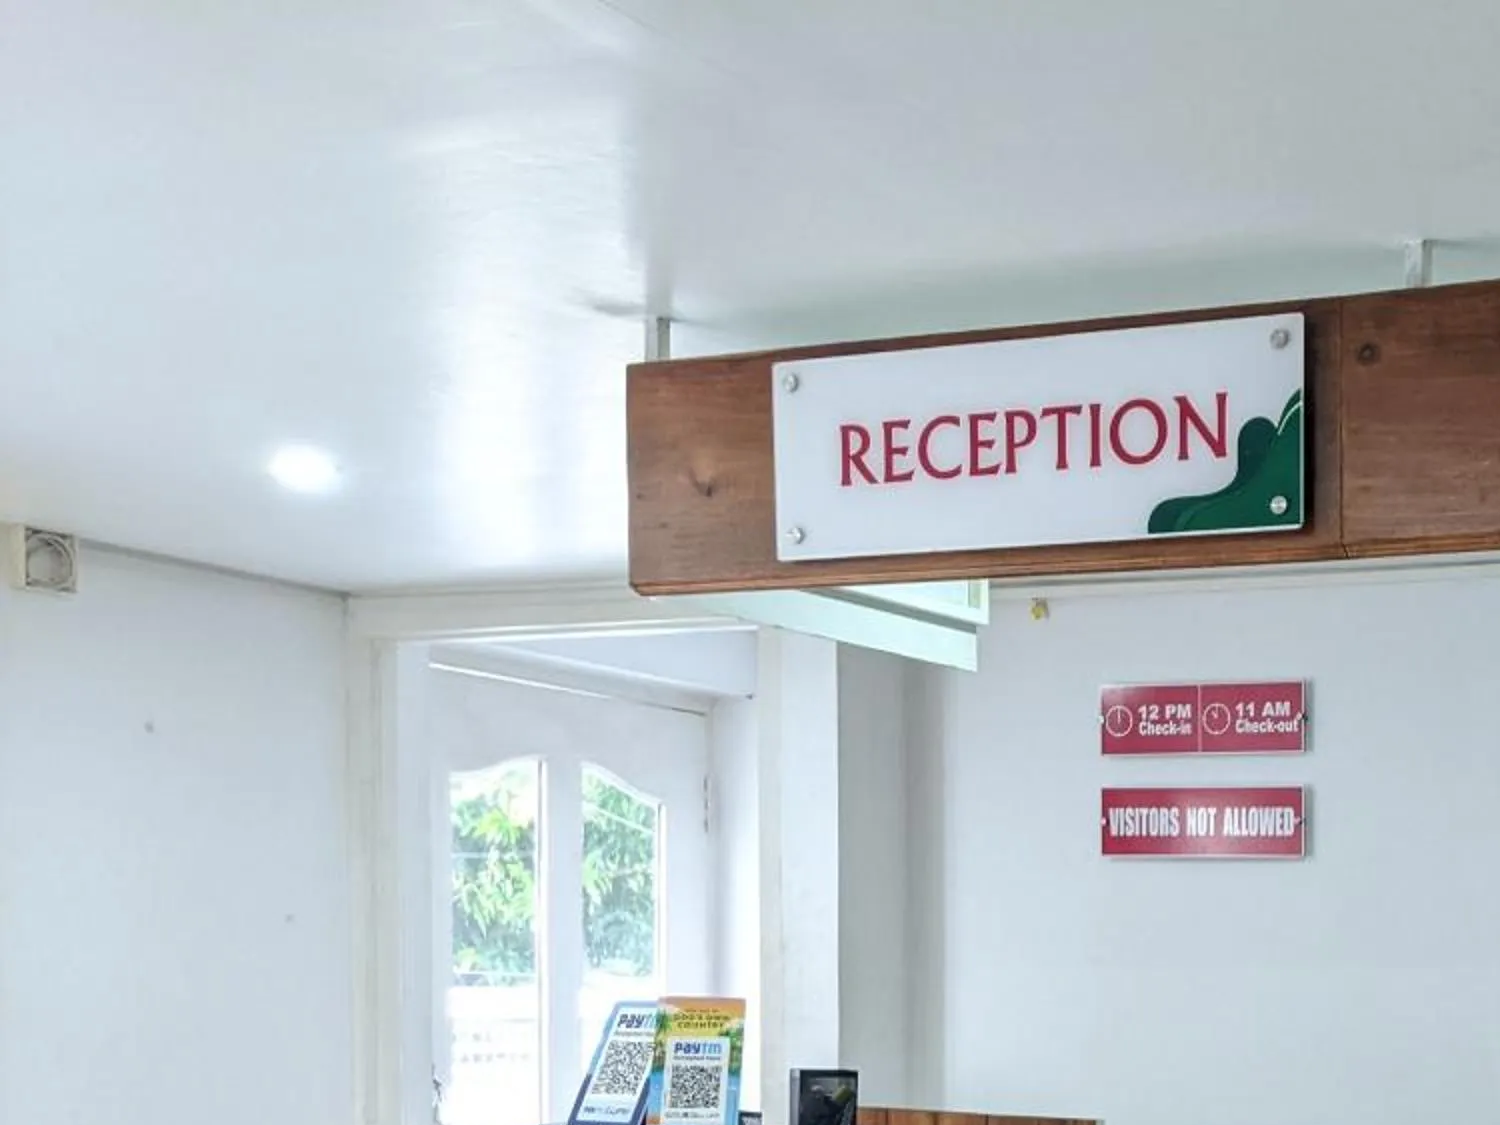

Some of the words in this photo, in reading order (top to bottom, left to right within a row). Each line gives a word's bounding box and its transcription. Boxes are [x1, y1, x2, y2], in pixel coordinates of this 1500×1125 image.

[838, 391, 1228, 487] RECEPTION
[1138, 704, 1159, 721] 12
[1165, 703, 1192, 719] PM
[1235, 702, 1255, 718] 11
[1262, 701, 1291, 717] AM
[1138, 720, 1193, 736] Check-in
[1235, 717, 1299, 734] Check-out
[1108, 806, 1180, 837] VISITORS
[1186, 806, 1217, 837] NOT
[1223, 806, 1295, 837] ALLOWED
